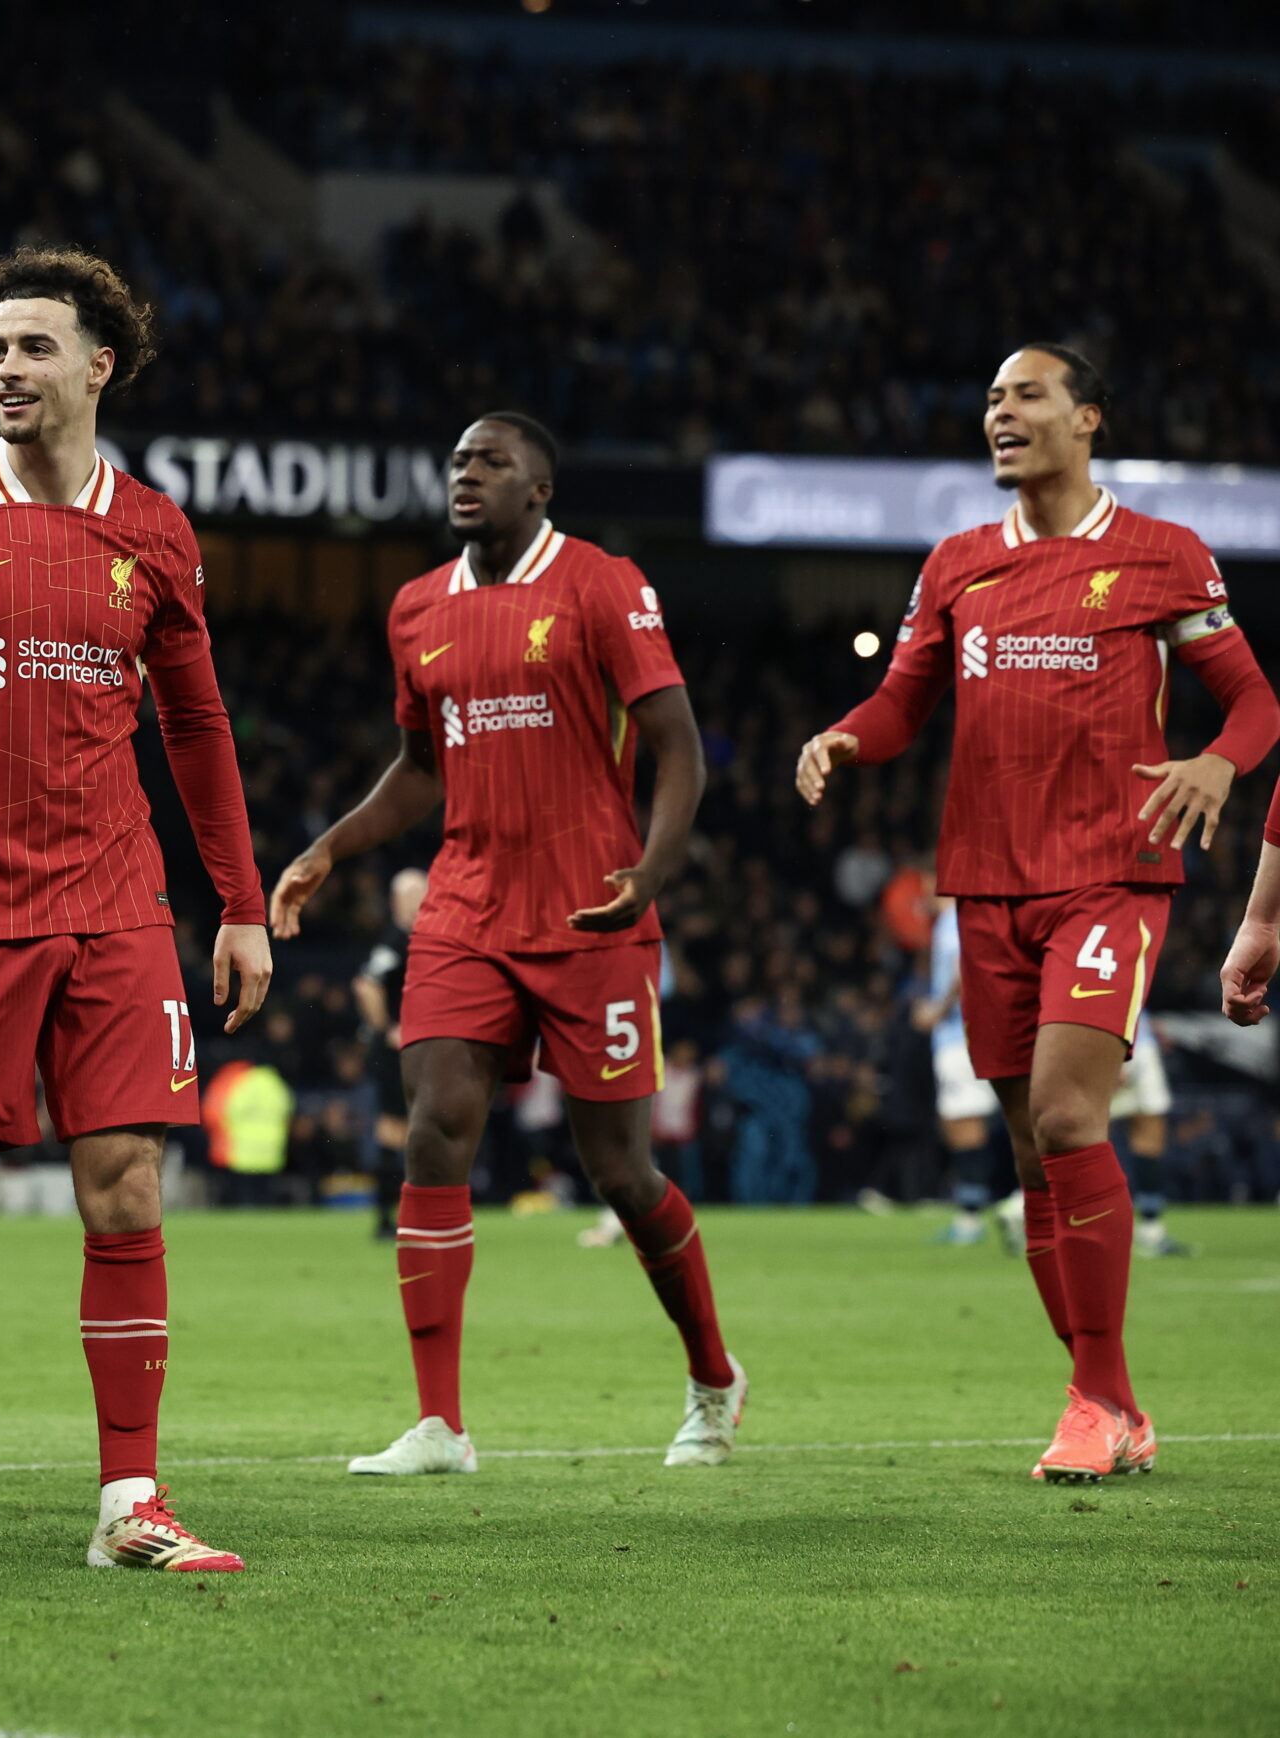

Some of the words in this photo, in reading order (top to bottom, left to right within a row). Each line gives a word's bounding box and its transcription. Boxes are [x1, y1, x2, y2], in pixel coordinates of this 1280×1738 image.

[18, 636, 124, 666] standard
[995, 634, 1095, 654] standard
[17, 658, 124, 687] chartered
[995, 650, 1099, 672] chartered
[466, 692, 548, 716] standard
[467, 709, 554, 735] chartered
[1076, 924, 1118, 981] 4
[605, 1000, 640, 1060] 5
